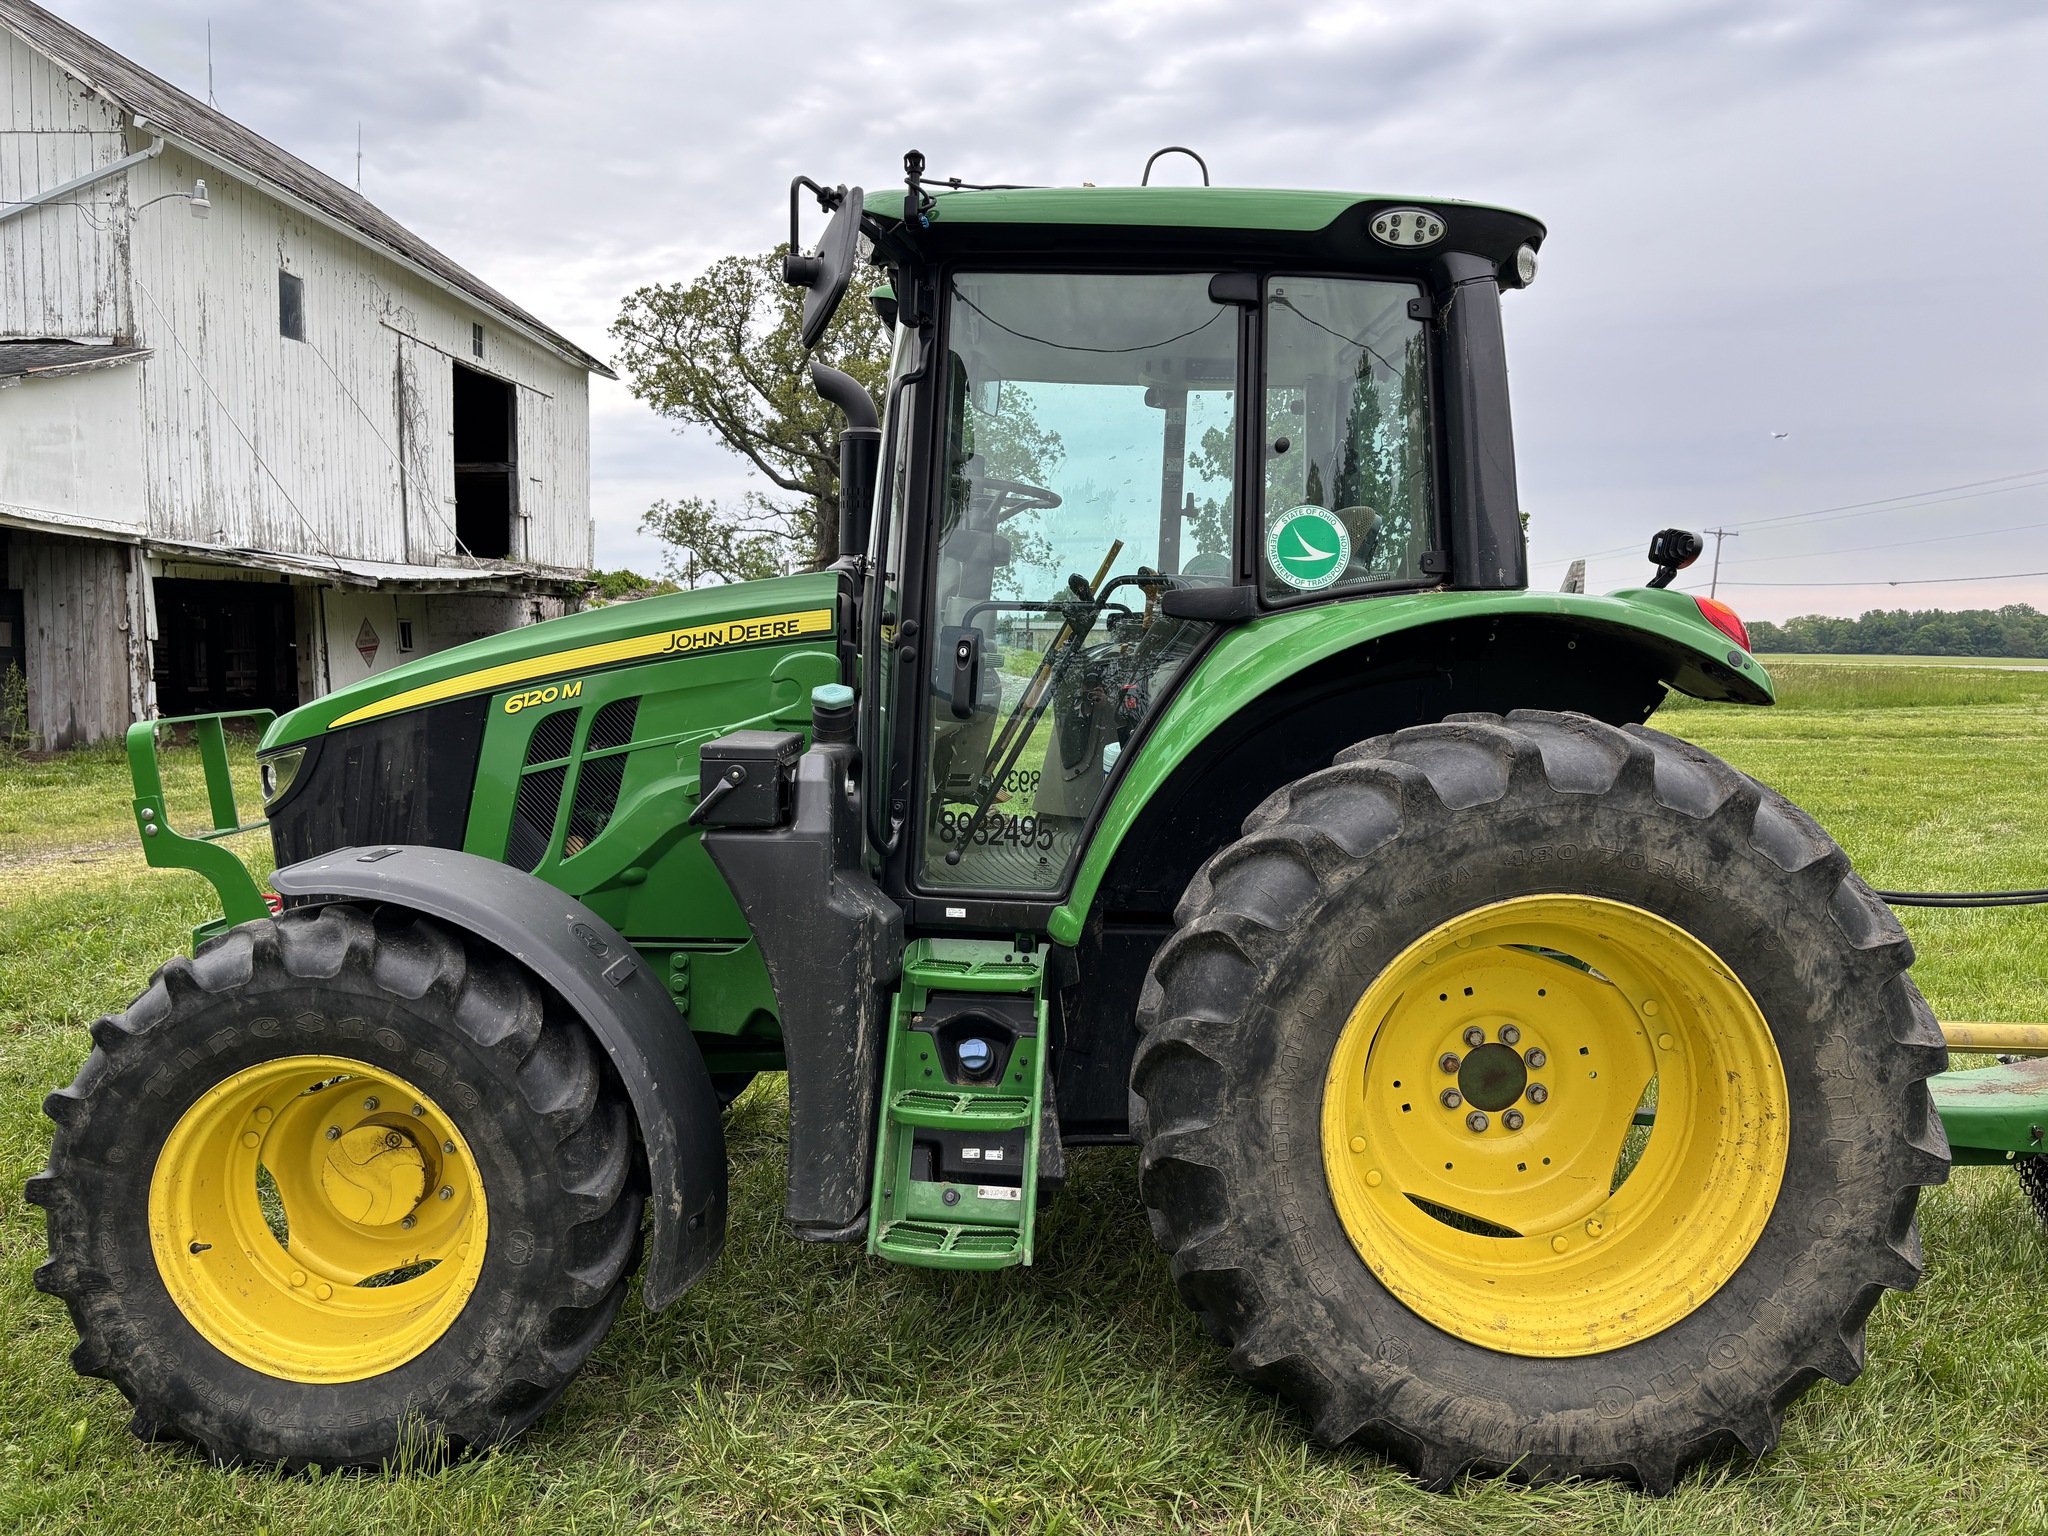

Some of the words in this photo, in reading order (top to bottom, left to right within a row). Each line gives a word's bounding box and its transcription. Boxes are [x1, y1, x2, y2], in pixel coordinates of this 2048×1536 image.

[1281, 508, 1304, 524] STATE
[1318, 512, 1337, 526] OHIO
[1270, 533, 1294, 581] DEPARTMENT
[1308, 535, 1348, 587] TRANSPORTATION
[663, 631, 724, 651] JOHN
[728, 619, 800, 642] DEERE
[504, 686, 559, 714] 6120
[561, 680, 583, 701] M
[940, 811, 1053, 850] 8932495
[145, 1011, 480, 1109] Firestone
[1271, 988, 1341, 1297] PERFORMER
[1328, 923, 1375, 971] 70
[1396, 864, 1473, 910] EXTRA
[319, 1289, 514, 1428] PERFORMER
[186, 1373, 245, 1414] EXTRA
